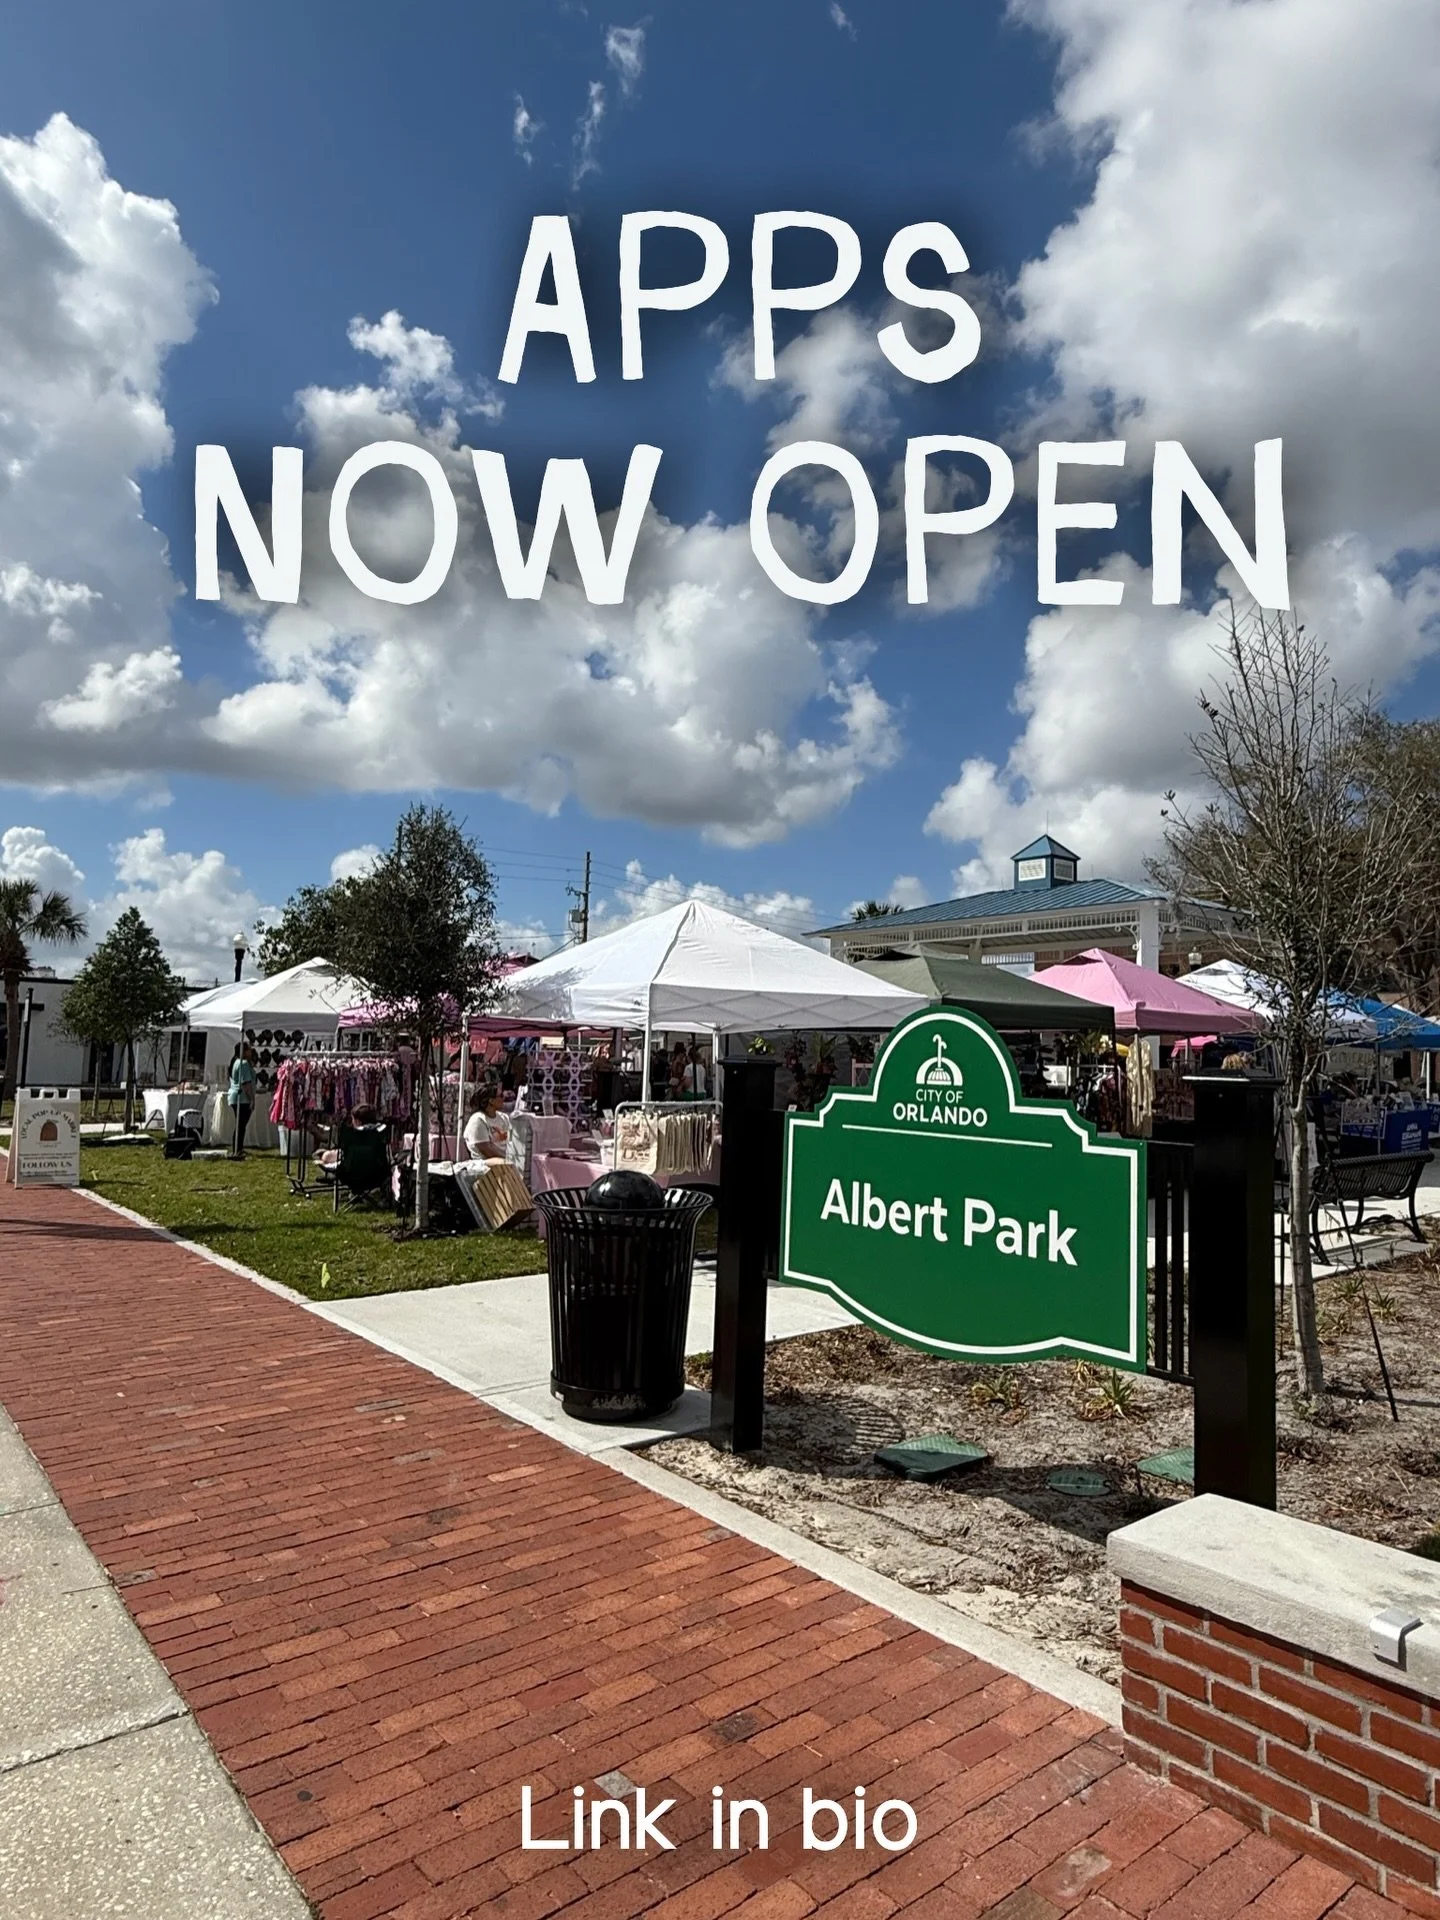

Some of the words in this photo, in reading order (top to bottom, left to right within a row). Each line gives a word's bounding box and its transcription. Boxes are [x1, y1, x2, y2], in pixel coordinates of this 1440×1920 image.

[915, 1087, 944, 1103] CITY
[945, 1089, 964, 1104] OF
[892, 1102, 988, 1128] ORLANDO
[22, 1161, 57, 1169] FOLLOW
[819, 1178, 948, 1243] Albert
[963, 1197, 1079, 1267] Park
